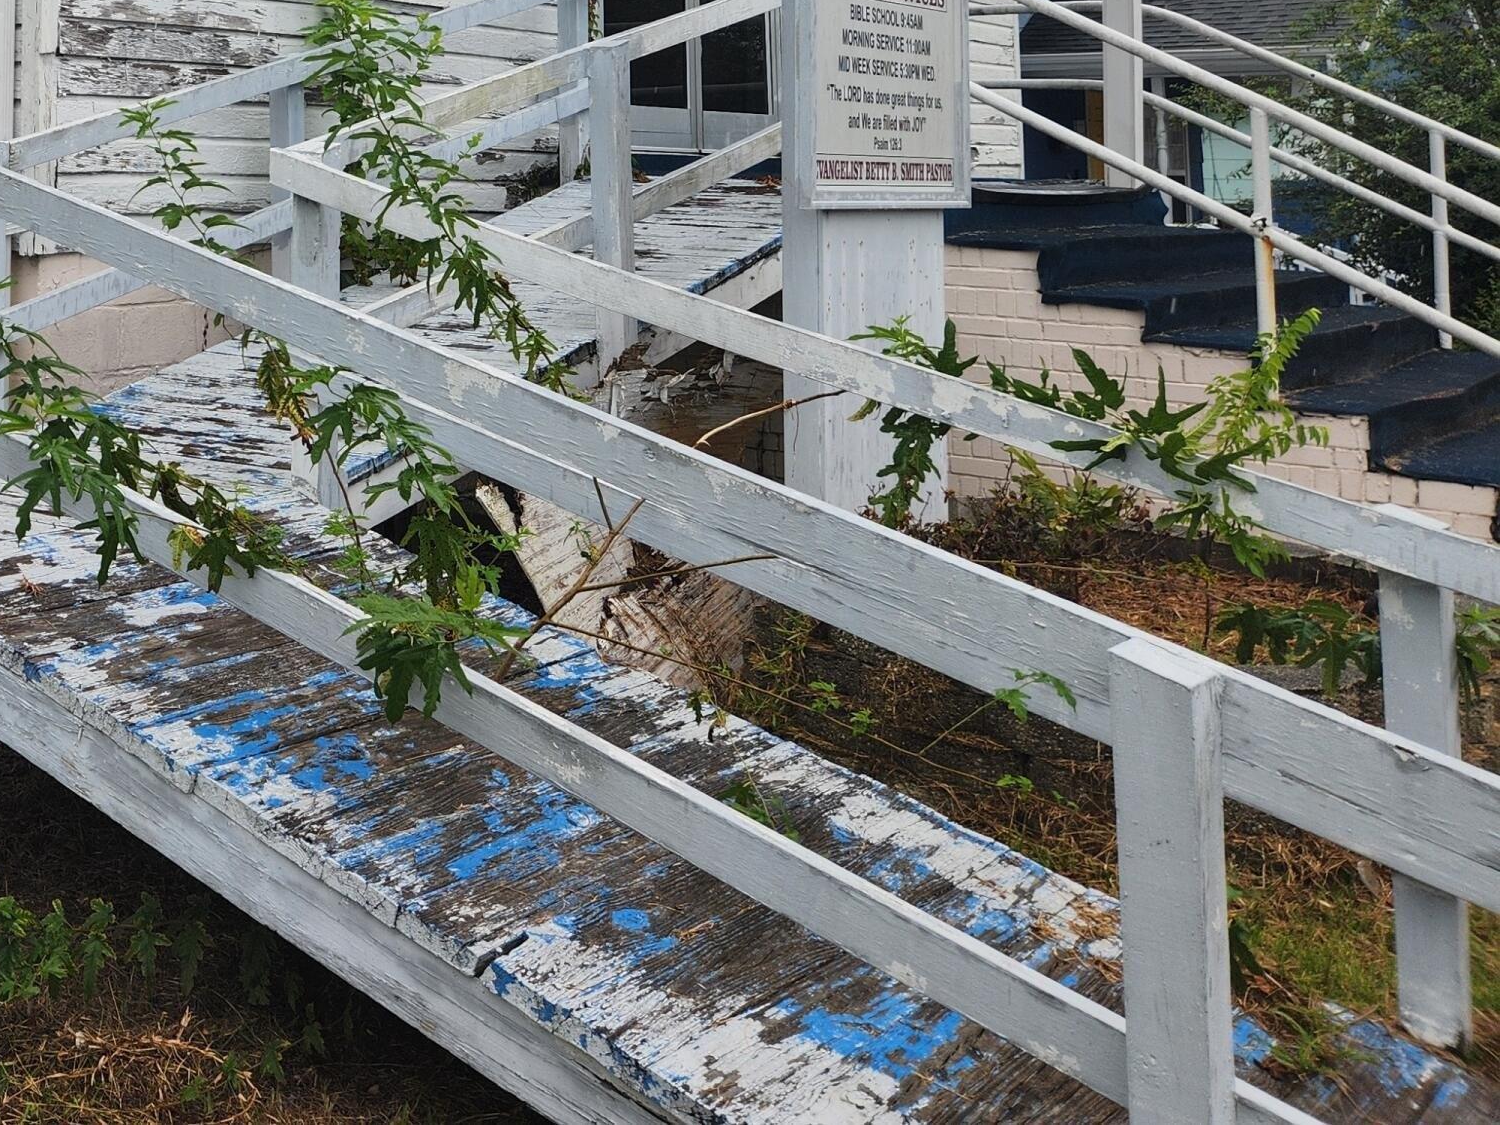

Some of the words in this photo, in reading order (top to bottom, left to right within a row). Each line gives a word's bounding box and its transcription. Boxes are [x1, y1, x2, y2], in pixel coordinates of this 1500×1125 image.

[850, 4, 870, 23] BIBLE
[871, 7, 900, 27] SCHOOL
[901, 12, 923, 30] 9:45AM
[842, 28, 875, 48] MORNING
[876, 33, 904, 52] SERVICE
[906, 38, 931, 55] 11:00AM
[838, 55, 850, 72] MID
[852, 56, 871, 74] WEEK
[872, 59, 898, 78] SERVICE
[921, 65, 936, 81] WED.
[843, 85, 861, 102] LORD
[863, 87, 874, 104] has
[875, 88, 890, 105] done
[891, 91, 906, 109] great
[907, 91, 924, 111] things
[925, 93, 933, 109] for
[848, 112, 860, 128] and
[861, 113, 871, 129] We
[872, 117, 882, 130] are
[883, 114, 897, 131] filled
[899, 116, 911, 132] with
[865, 161, 891, 181] BETTY
[891, 162, 900, 181] B.
[901, 162, 924, 181] SMITH
[926, 163, 953, 182] PASTOR
